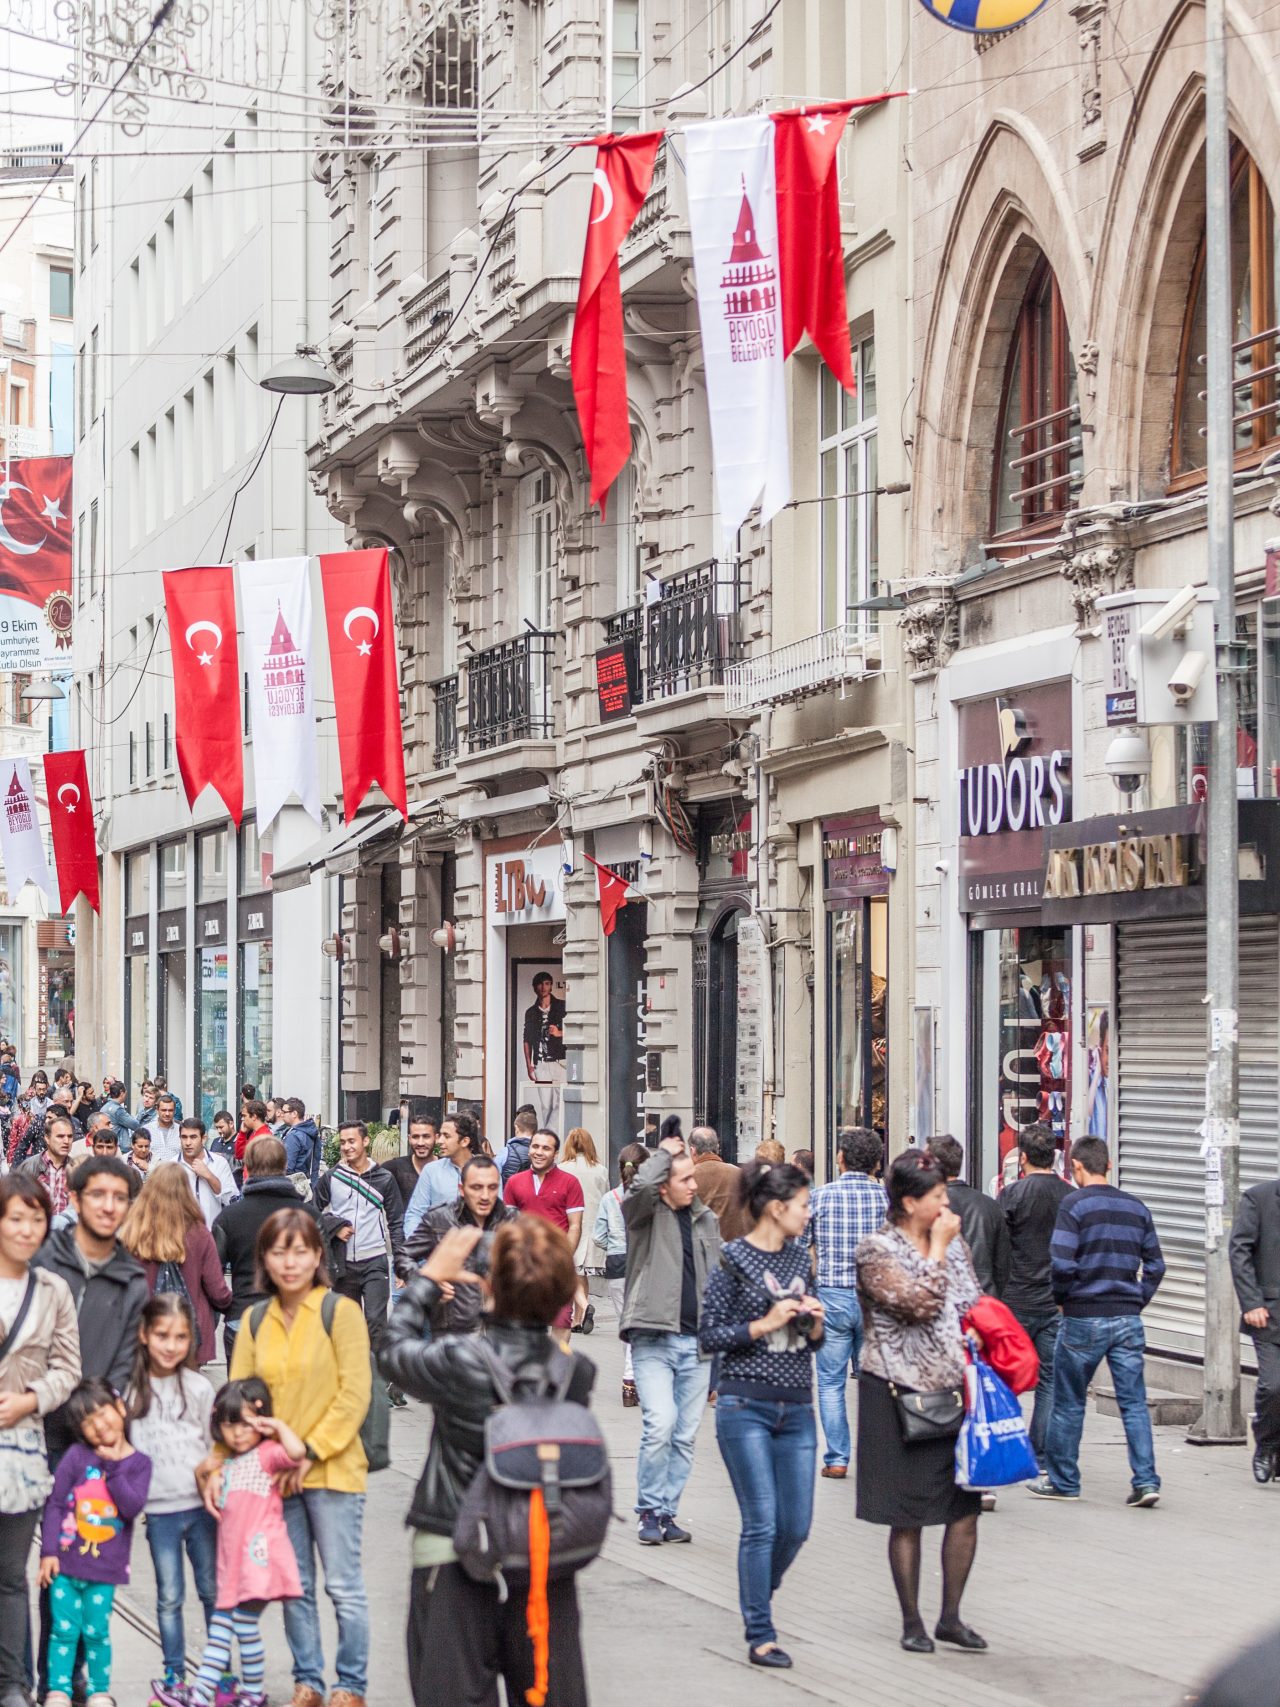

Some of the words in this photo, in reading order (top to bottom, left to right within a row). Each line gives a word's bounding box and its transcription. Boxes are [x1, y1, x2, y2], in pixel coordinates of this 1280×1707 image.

[731, 338, 776, 363] BELEDİYE
[12, 620, 38, 633] Ekim
[20, 659, 42, 669] Olsun
[957, 750, 1064, 837] TUDORS
[856, 832, 881, 856] HILFIGE
[1042, 848, 1081, 899] AK
[968, 882, 1008, 900] GÖMLEK
